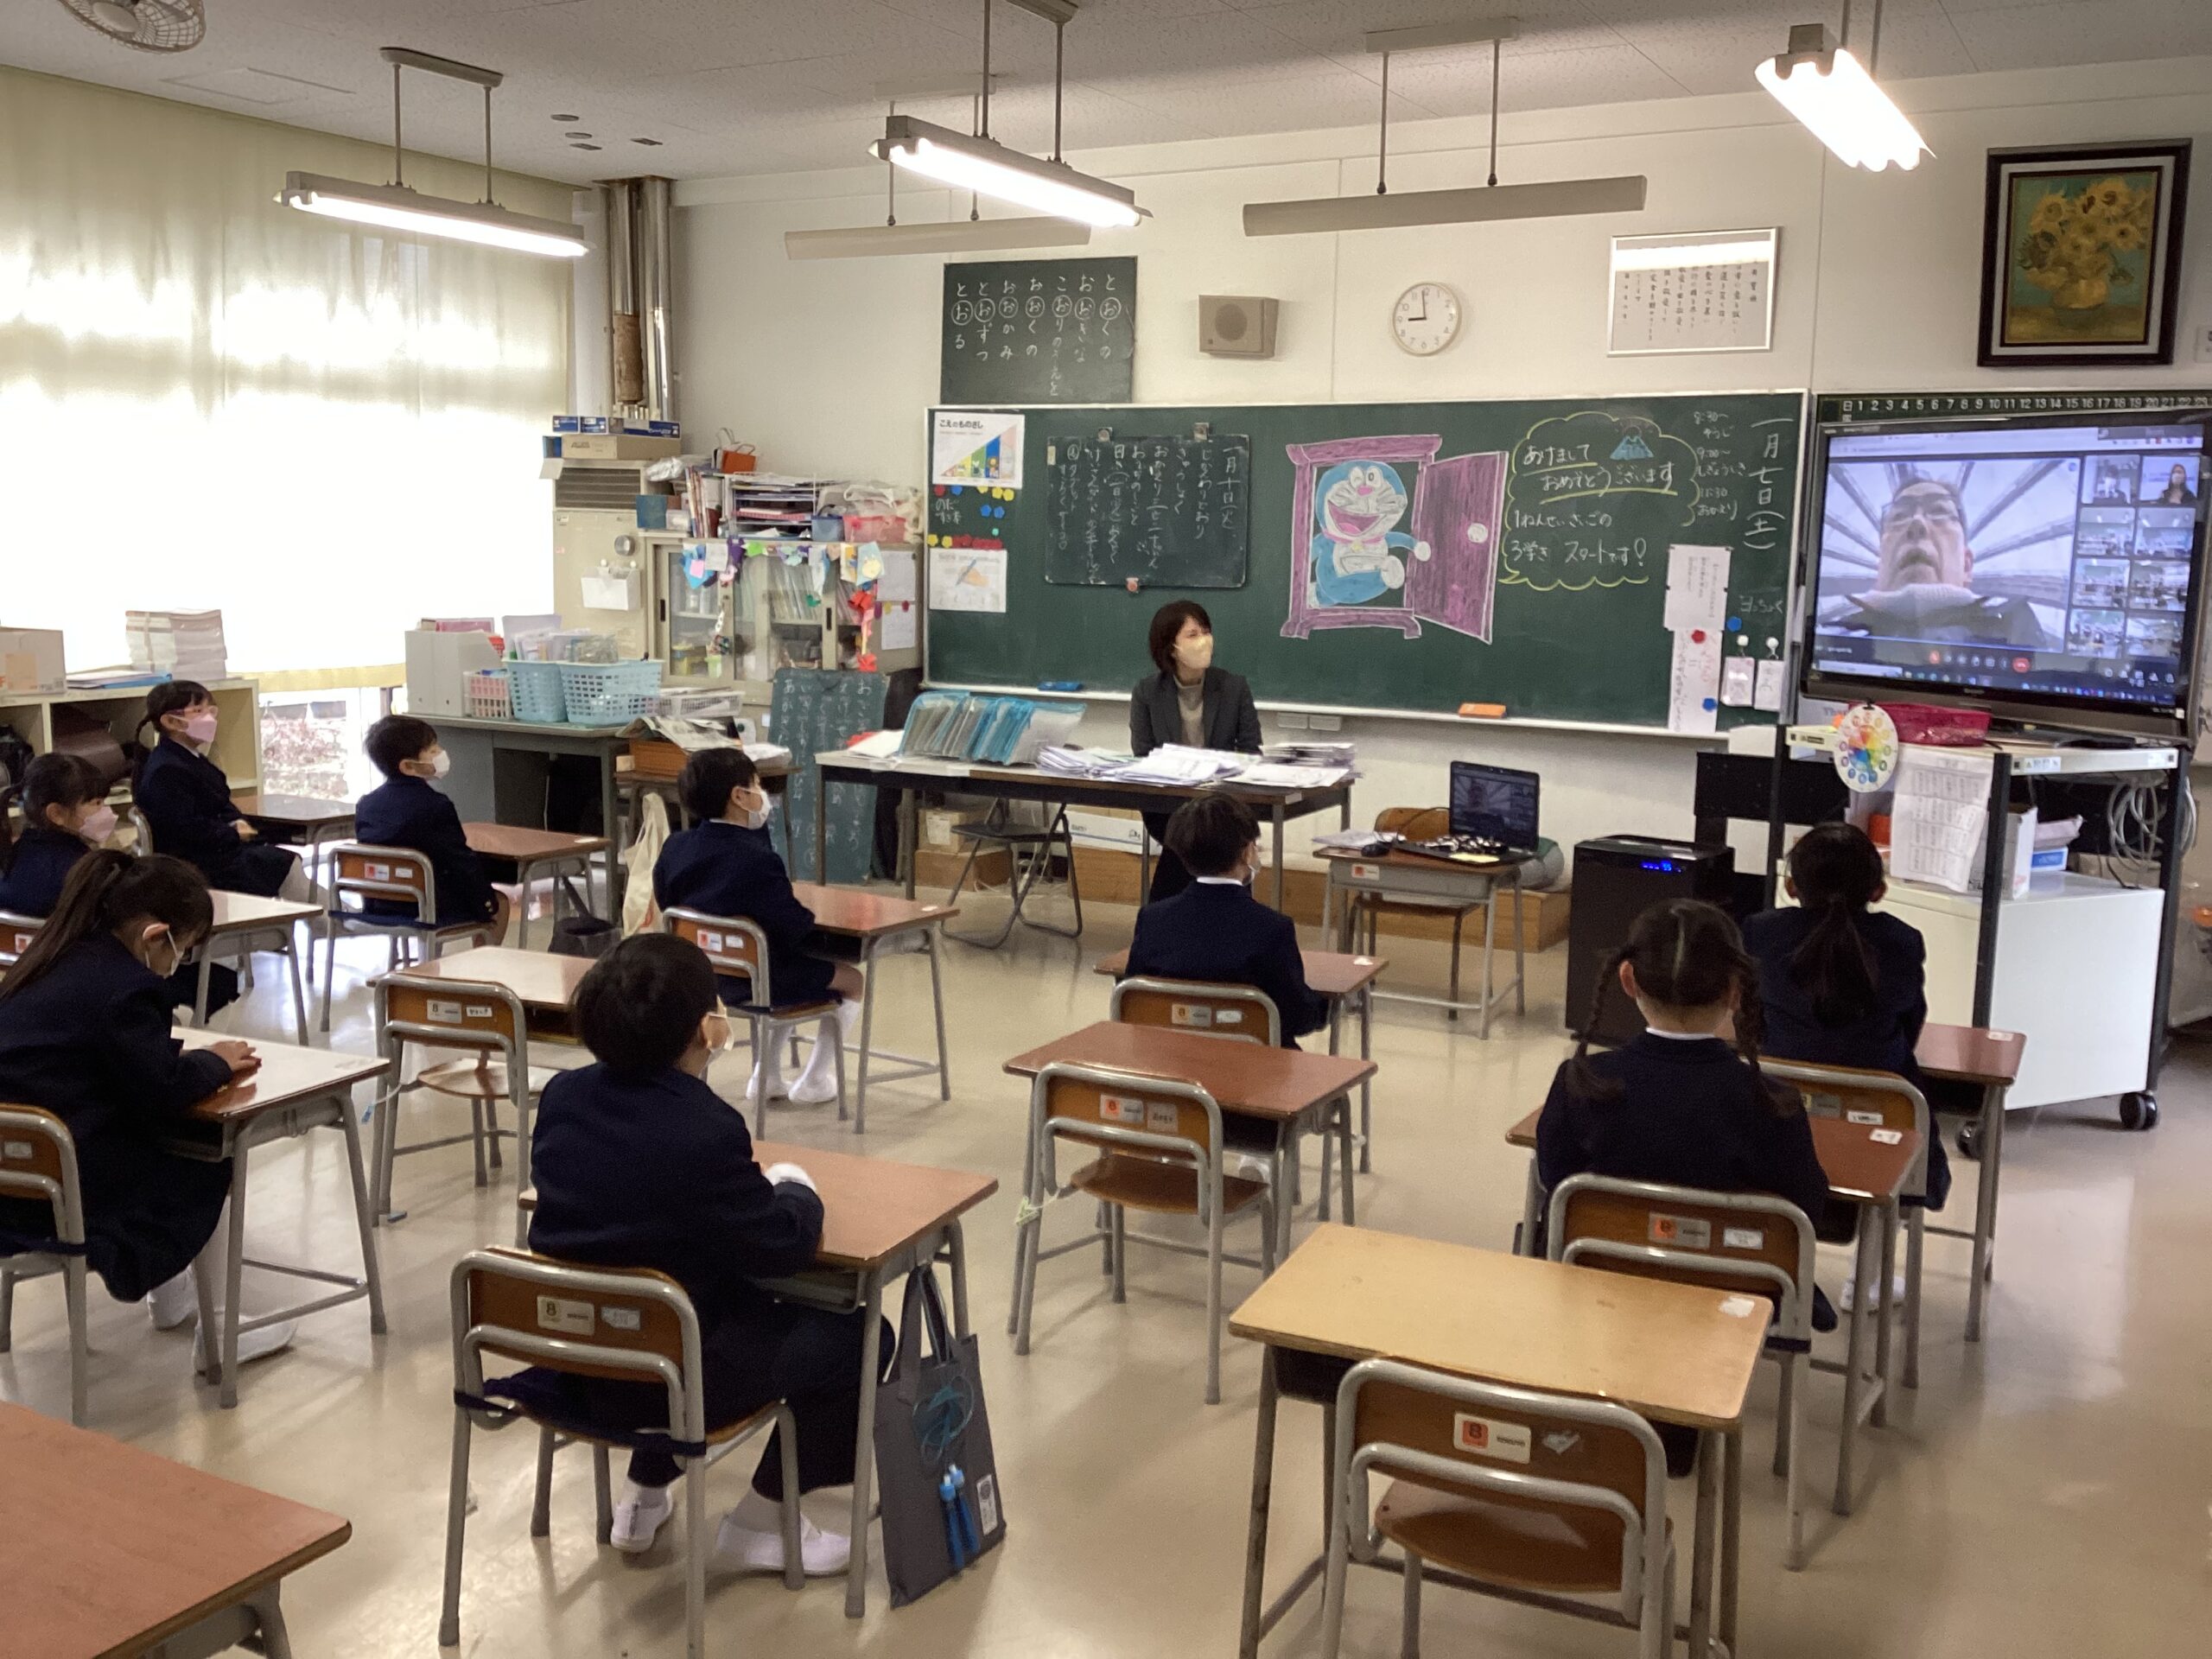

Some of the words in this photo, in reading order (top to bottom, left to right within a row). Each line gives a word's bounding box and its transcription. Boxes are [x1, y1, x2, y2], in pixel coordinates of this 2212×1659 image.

[951, 283, 973, 349] とおる
[1843, 400, 1853, 411] 日
[1859, 400, 1863, 410] 1
[1871, 400, 1878, 410] 2
[1886, 400, 1894, 410] 3
[1901, 400, 1909, 410] 4
[1916, 400, 1924, 410] 5
[1931, 399, 1939, 410] 6
[1947, 399, 1955, 410] 7
[1961, 399, 1968, 410] 8
[1975, 399, 1983, 410] 9
[1990, 399, 2000, 410] 10
[2005, 398, 2015, 409] 11
[2020, 398, 2031, 409] 12
[2036, 398, 2046, 409] 13
[2050, 398, 2062, 409] 14
[2066, 398, 2078, 408] 15
[2082, 398, 2094, 408] 16
[2098, 397, 2110, 408] 17
[2113, 397, 2126, 408] 18
[2129, 397, 2142, 408] 19
[939, 419, 983, 429] こえのものさし
[1523, 444, 1590, 466] あけまして
[1541, 461, 1675, 497] おめでとうございます
[1511, 540, 1548, 562] 3学き
